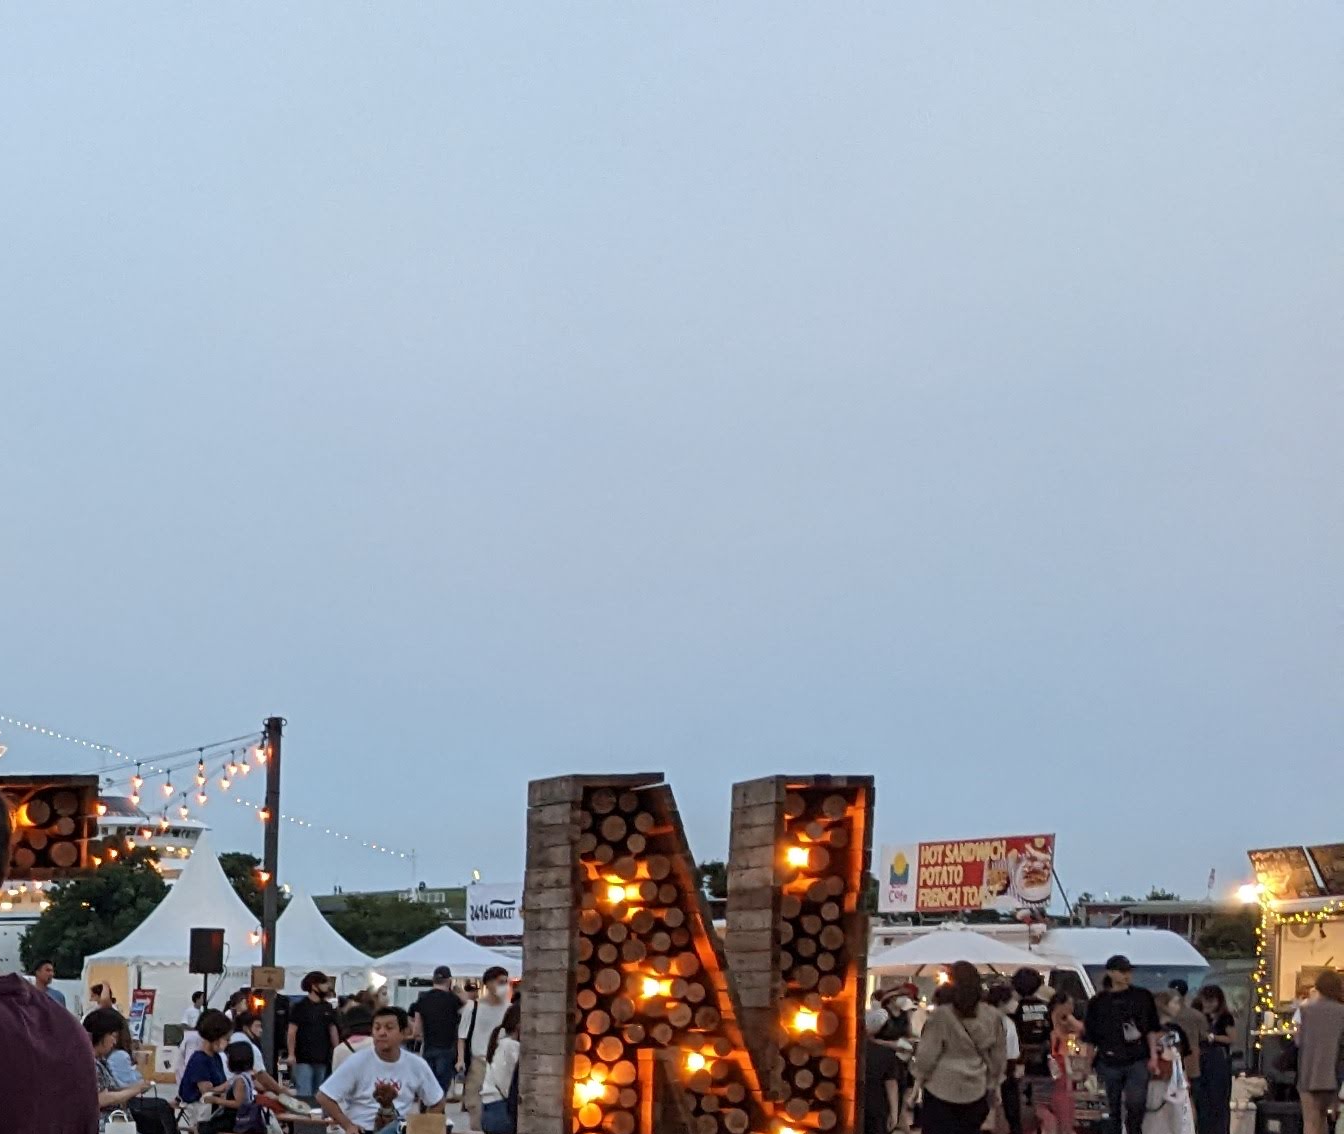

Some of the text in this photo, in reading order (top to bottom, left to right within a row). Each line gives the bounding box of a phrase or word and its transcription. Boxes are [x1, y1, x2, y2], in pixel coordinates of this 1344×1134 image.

[920, 840, 1007, 866] HOT SANDWICH
[919, 864, 964, 886] POTATO
[918, 886, 962, 908] FRENCH
[470, 904, 516, 921] 2416 MARKET
